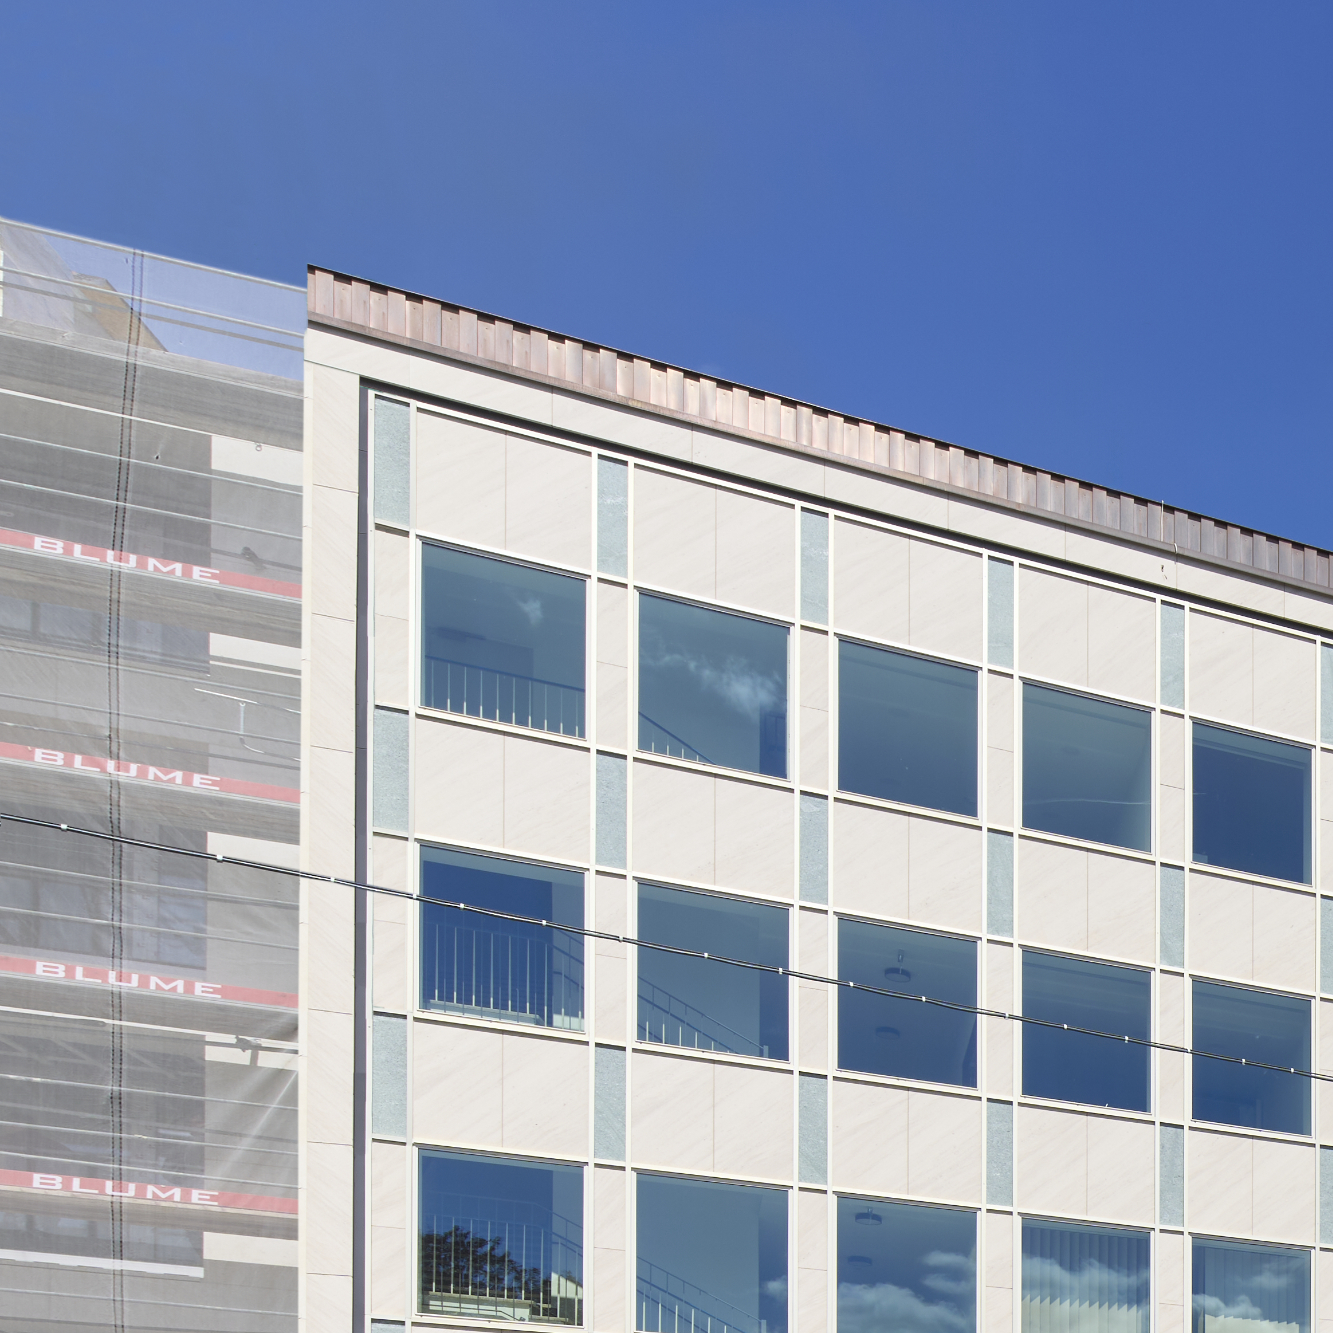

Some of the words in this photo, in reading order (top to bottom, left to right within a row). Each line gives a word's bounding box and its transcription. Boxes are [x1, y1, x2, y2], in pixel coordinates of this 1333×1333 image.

[33, 537, 220, 583] BLUME
[34, 748, 220, 790] BLUME
[35, 961, 222, 998] BLUME
[32, 1173, 219, 1205] BLUME
